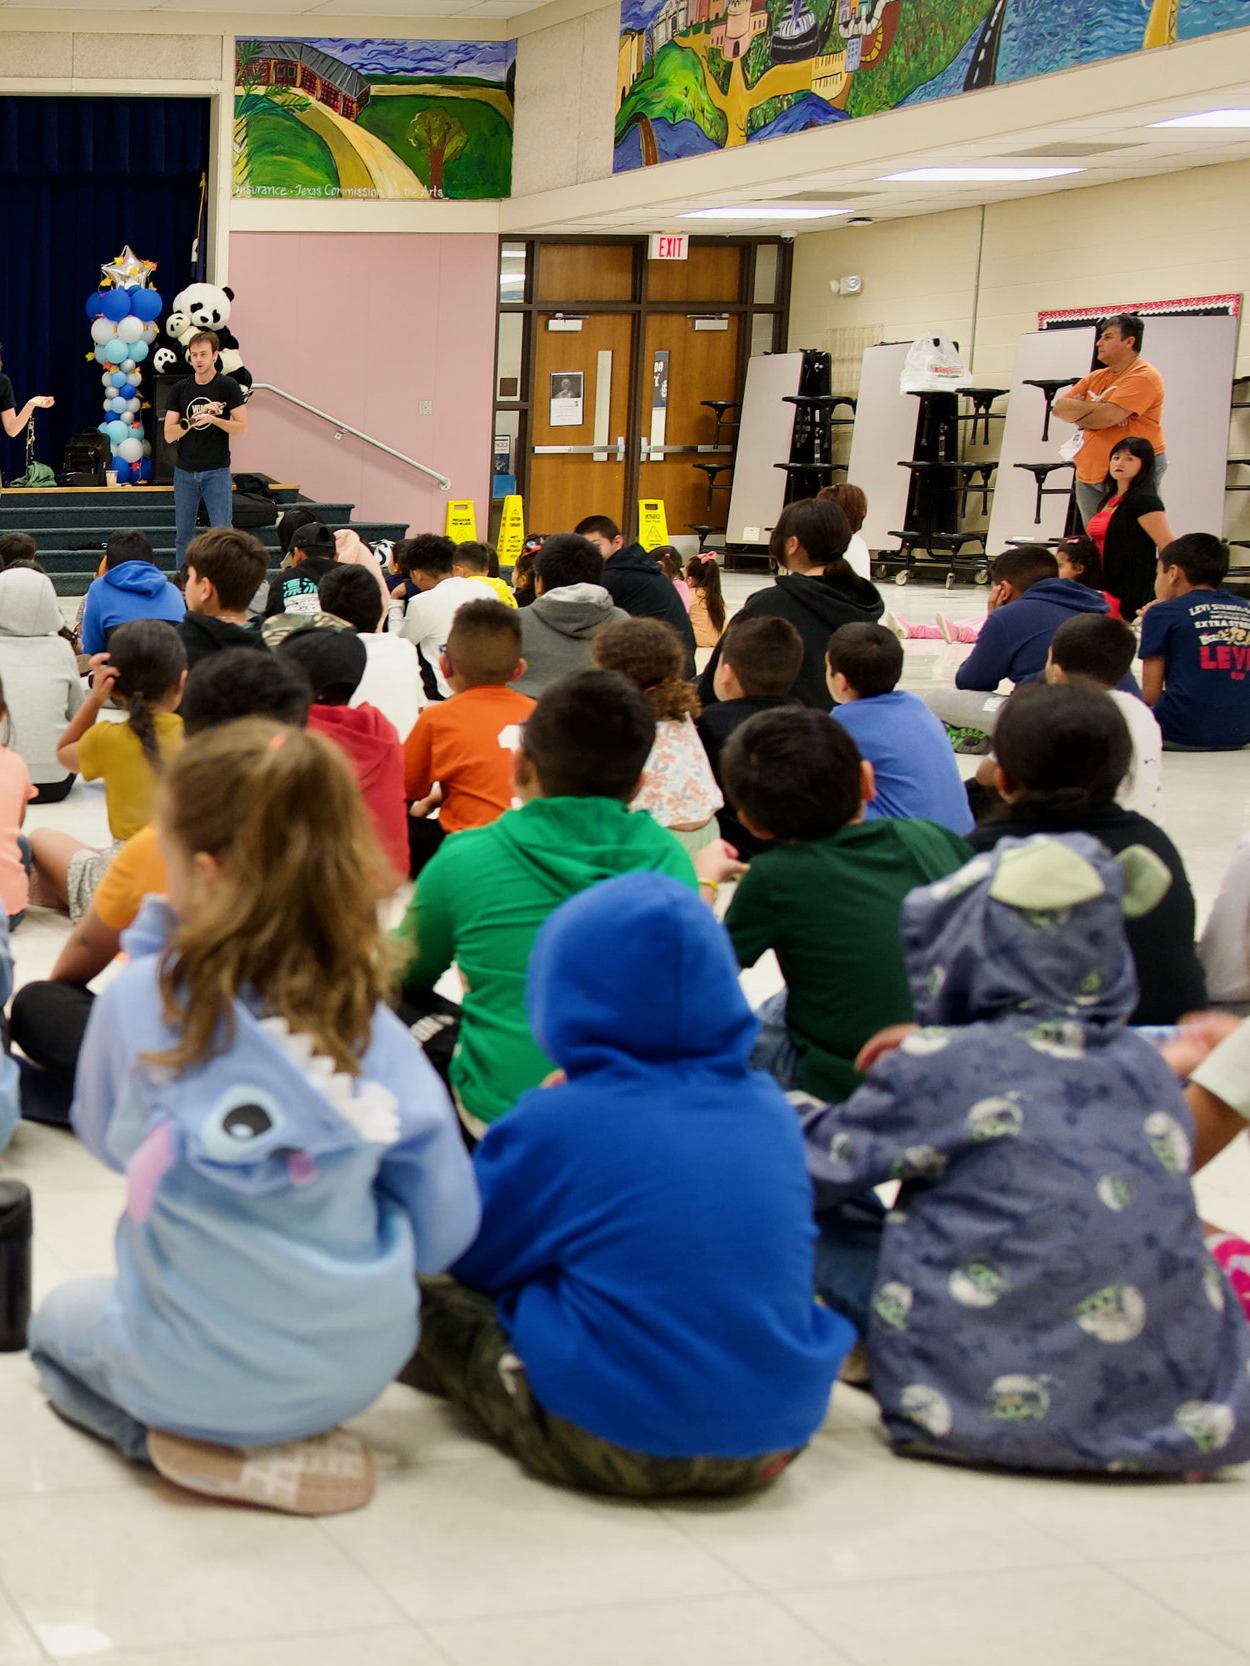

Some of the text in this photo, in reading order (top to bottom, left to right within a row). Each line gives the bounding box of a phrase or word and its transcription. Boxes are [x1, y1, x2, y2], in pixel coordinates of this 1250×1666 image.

[295, 184, 322, 197] Texas
[421, 184, 444, 197] Arts
[659, 237, 683, 257] EXIT
